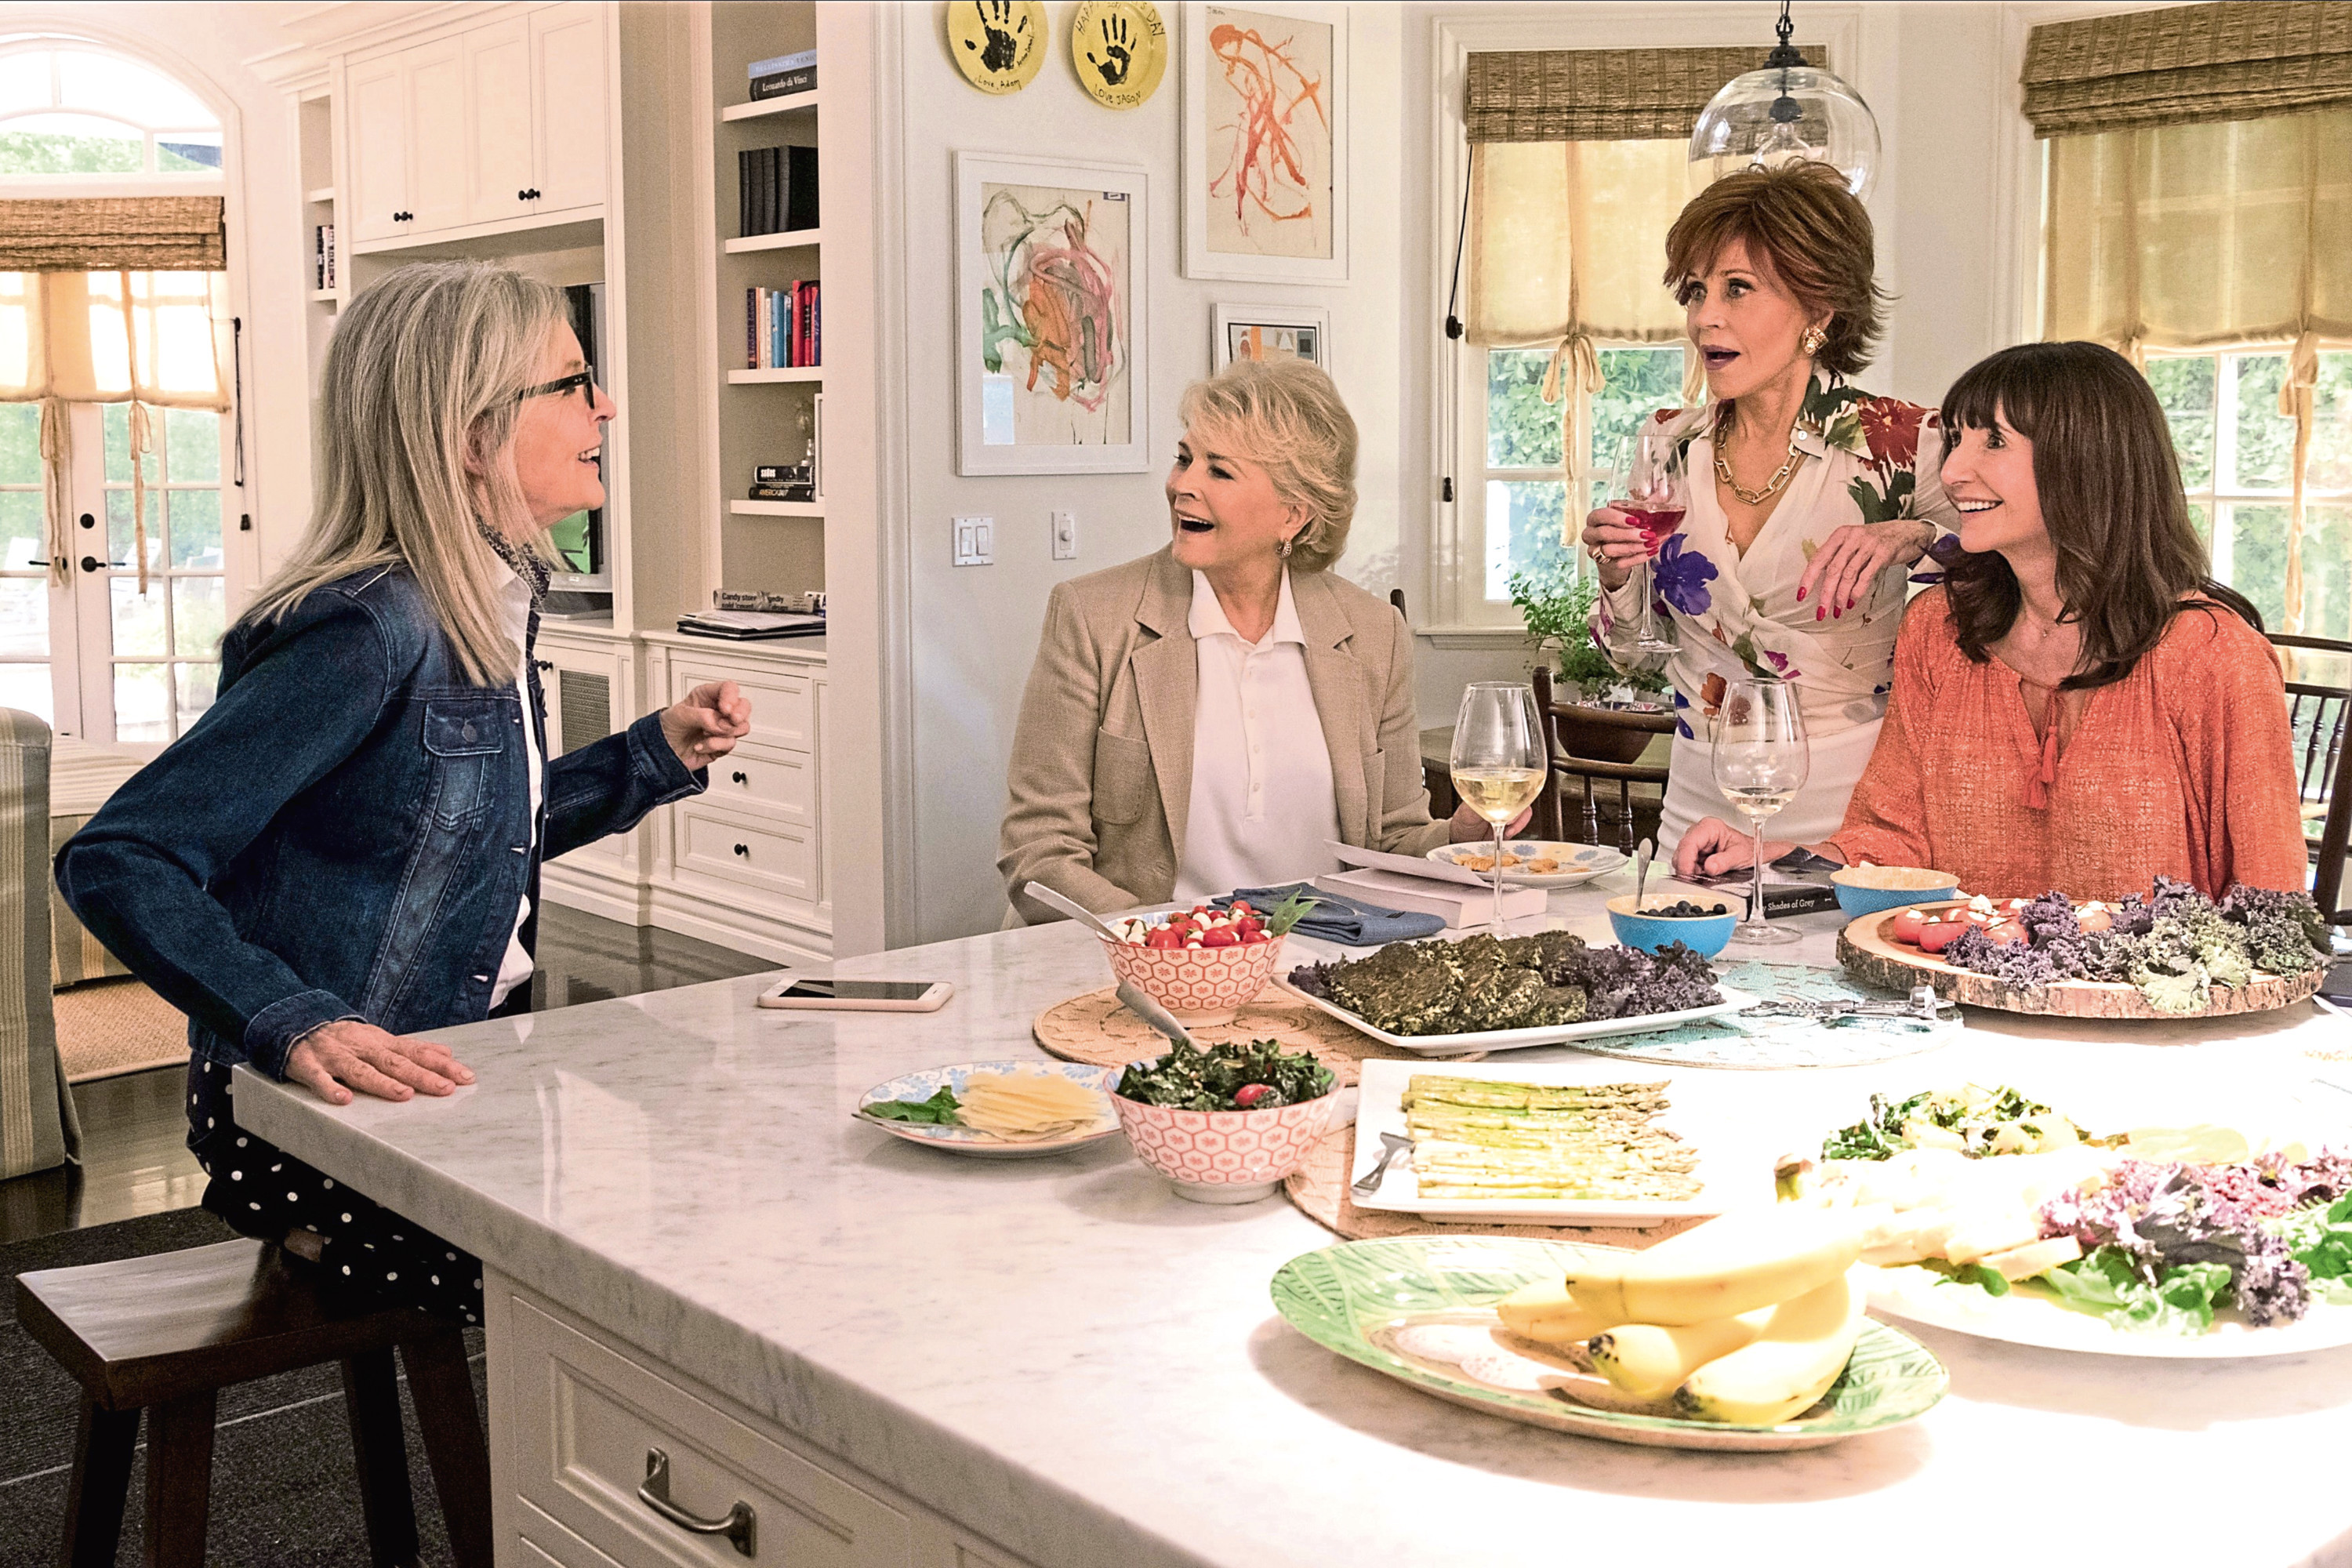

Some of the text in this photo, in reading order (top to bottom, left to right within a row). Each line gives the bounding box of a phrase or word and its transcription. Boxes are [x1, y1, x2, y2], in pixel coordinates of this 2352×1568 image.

[1146, 9, 1166, 36] DAY
[762, 74, 808, 92] Leonardo da Vinci
[1000, 79, 1022, 90] Adam
[1116, 91, 1141, 106] JASON
[722, 593, 741, 601] Candy
[1767, 901, 1791, 911] Shades
[1791, 899, 1798, 909] of
[1799, 898, 1815, 908] Grey
